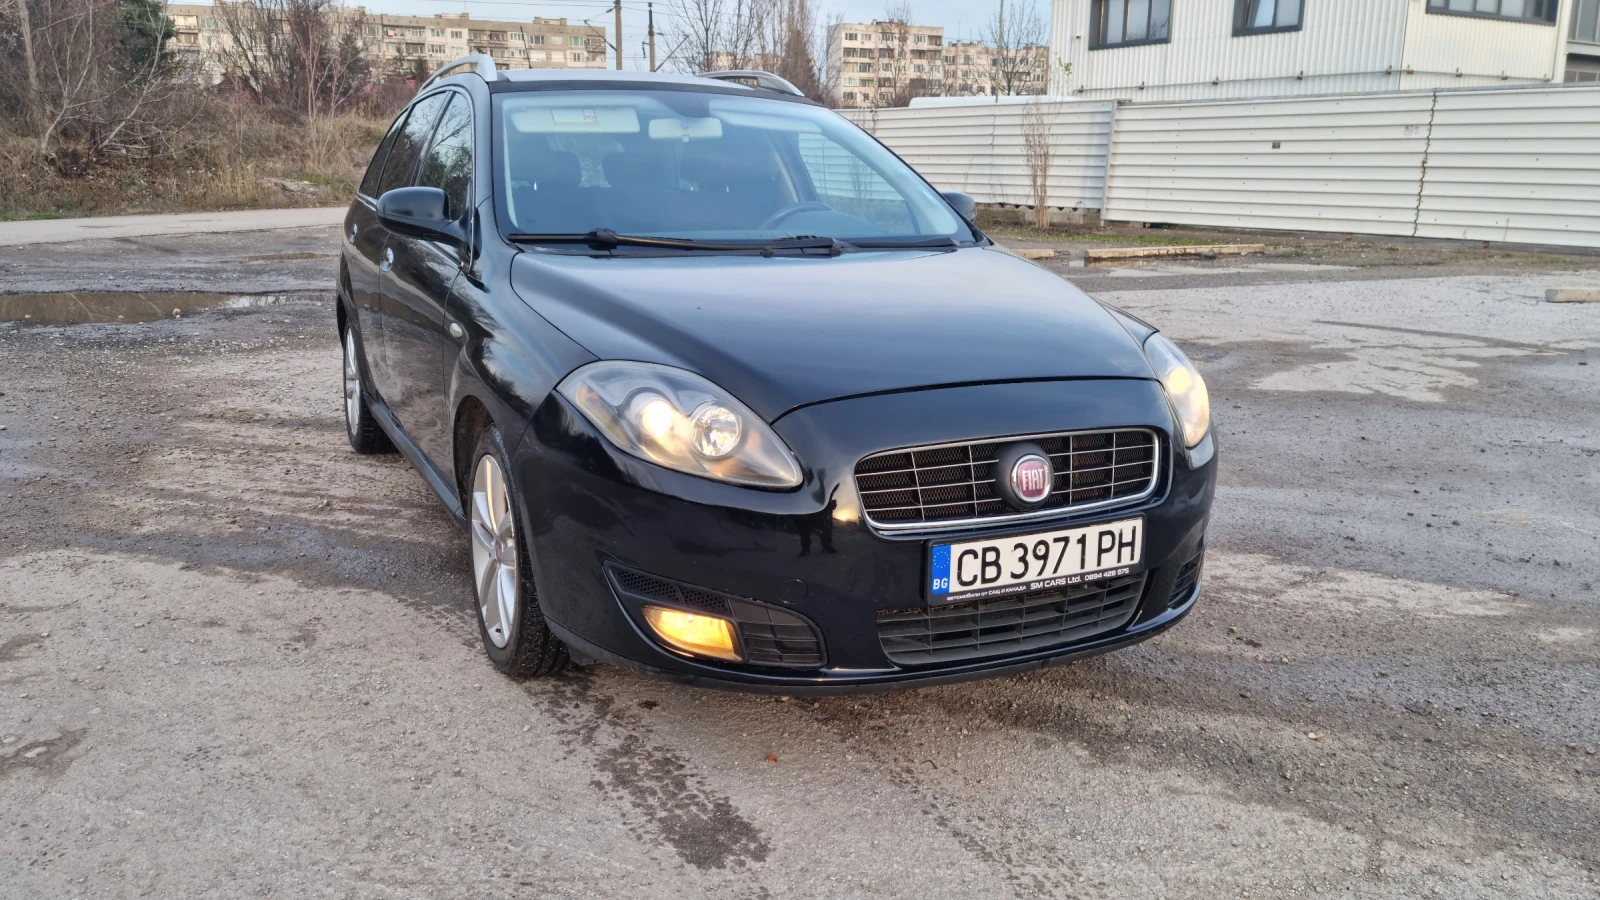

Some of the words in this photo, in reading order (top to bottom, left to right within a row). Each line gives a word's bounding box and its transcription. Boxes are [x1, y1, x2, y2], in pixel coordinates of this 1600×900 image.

[1022, 469, 1044, 491] FIAT
[957, 547, 1002, 587] CB
[1010, 533, 1087, 580] 3971
[1097, 526, 1137, 567] PH
[933, 578, 949, 591] BG
[1005, 585, 1027, 593] КАНАДА
[1030, 580, 1043, 590] SM
[1044, 577, 1066, 588] CARS
[1067, 575, 1082, 584] Ltd.
[1084, 572, 1102, 581] 0894
